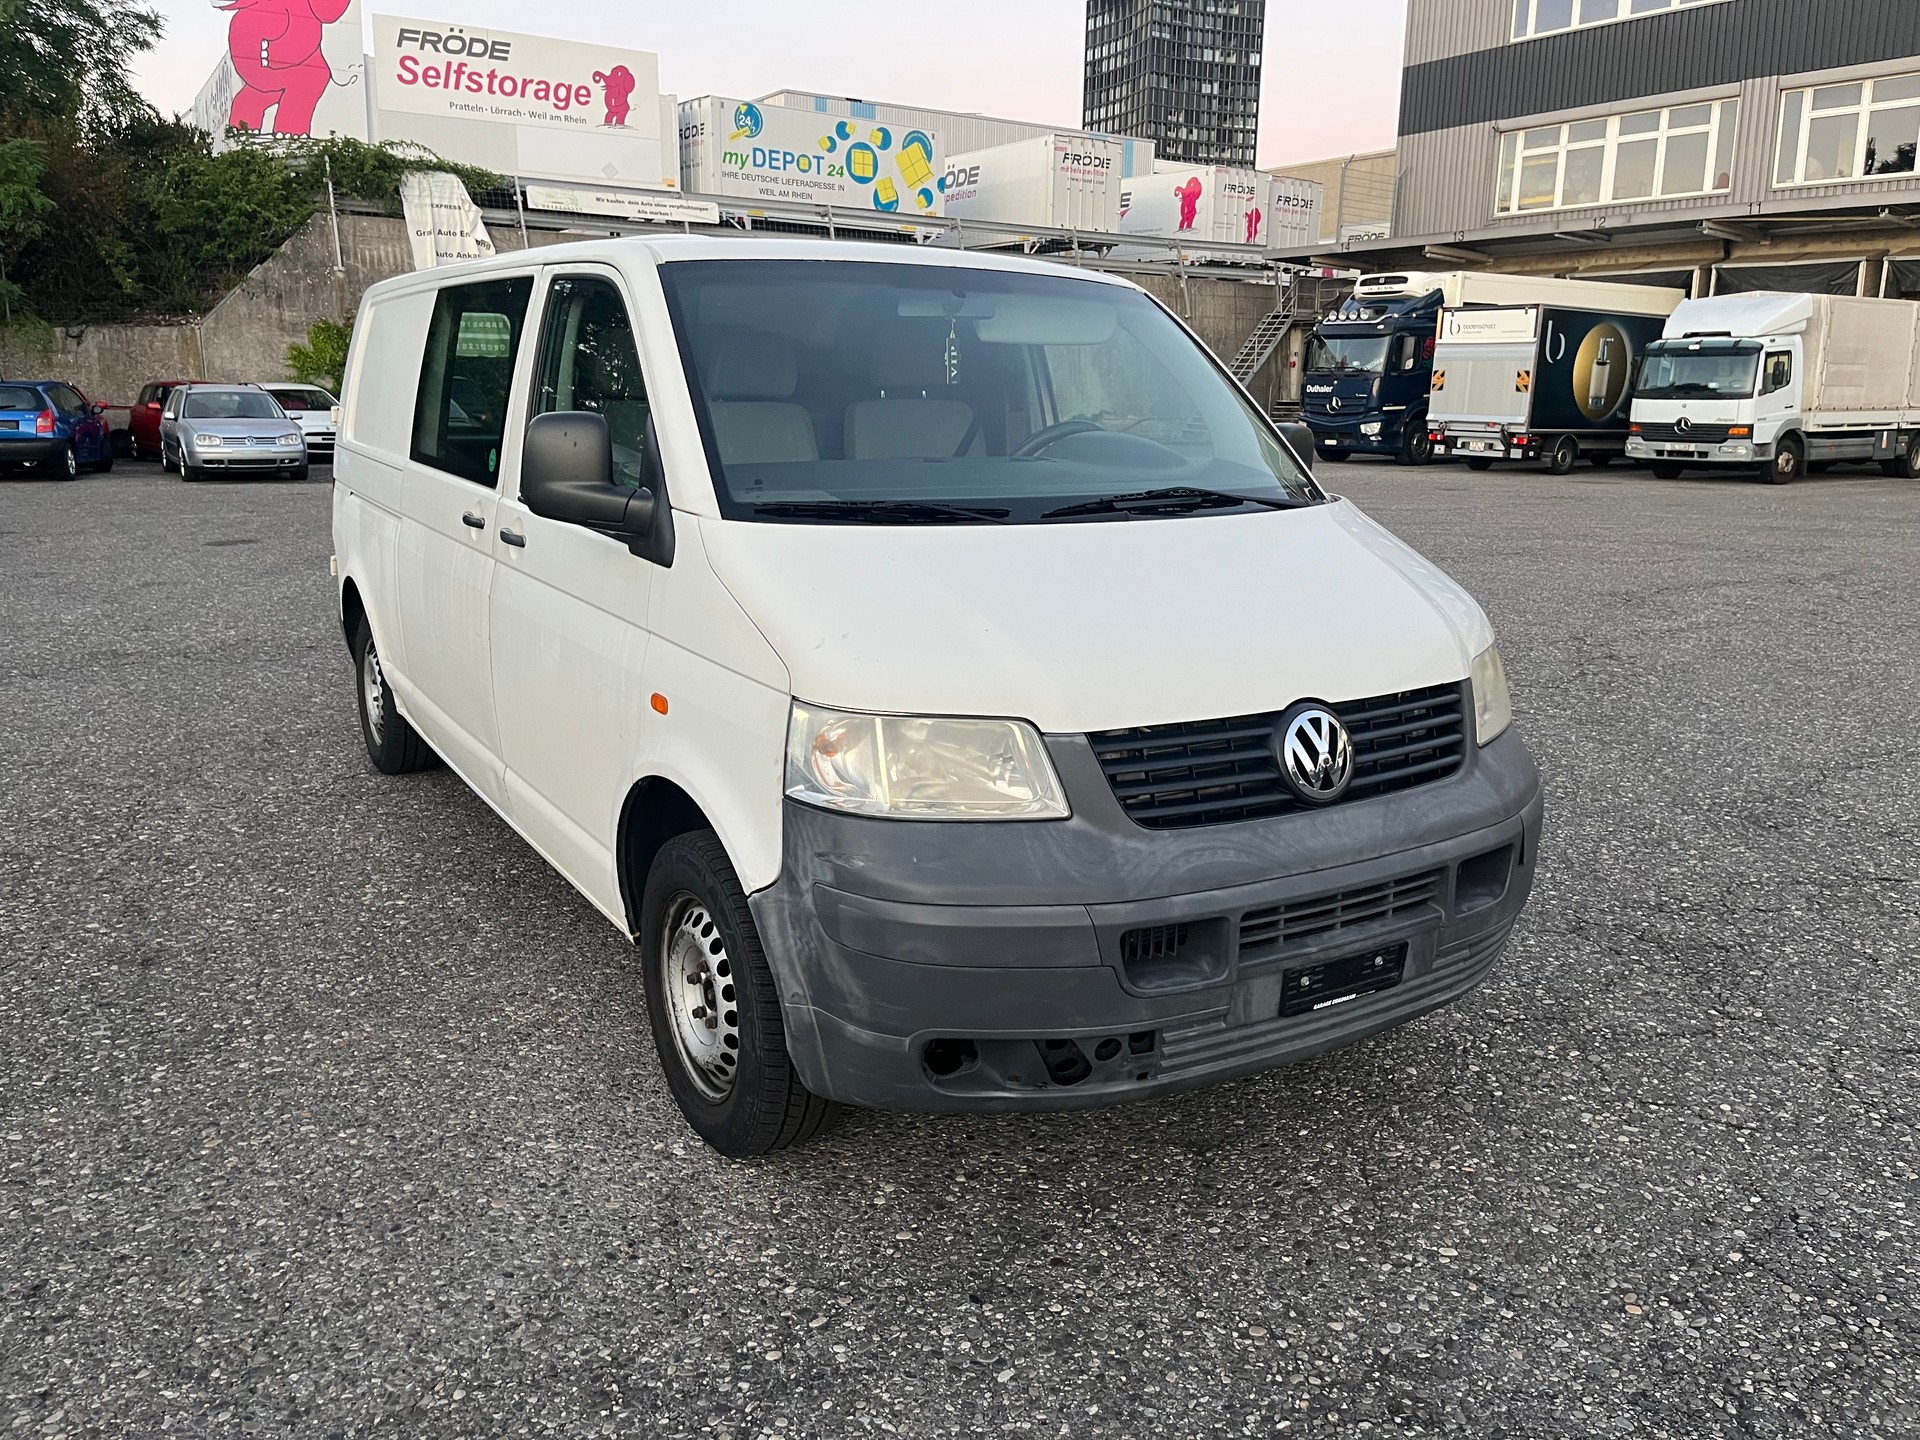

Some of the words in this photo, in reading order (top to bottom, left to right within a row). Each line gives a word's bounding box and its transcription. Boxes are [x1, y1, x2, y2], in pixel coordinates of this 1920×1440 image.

[397, 27, 511, 61] FRÖDE
[396, 55, 591, 110] Selfstorage
[528, 110, 547, 120] Weil
[549, 114, 562, 122] am
[564, 115, 587, 124] Rhein
[722, 150, 750, 171] my
[752, 147, 825, 175] DEPOT
[827, 164, 845, 178] 24
[1062, 151, 1112, 169] FRÖDE
[721, 170, 739, 180] IHRE
[741, 173, 780, 185] DEUTSCHE
[781, 178, 836, 190] LIEFERADRESSE
[759, 187, 776, 197] WEIL
[778, 190, 790, 198] AM
[791, 191, 813, 200] RHEIN
[1223, 182, 1255, 195] FRÖDE
[1276, 194, 1313, 209] FRÖDE
[1748, 202, 1762, 215] 11
[1593, 216, 1607, 229] 12
[437, 229, 457, 237] Auto
[1453, 230, 1465, 242] 13
[1340, 242, 1350, 252] 14
[1306, 384, 1334, 393] Duthaler
